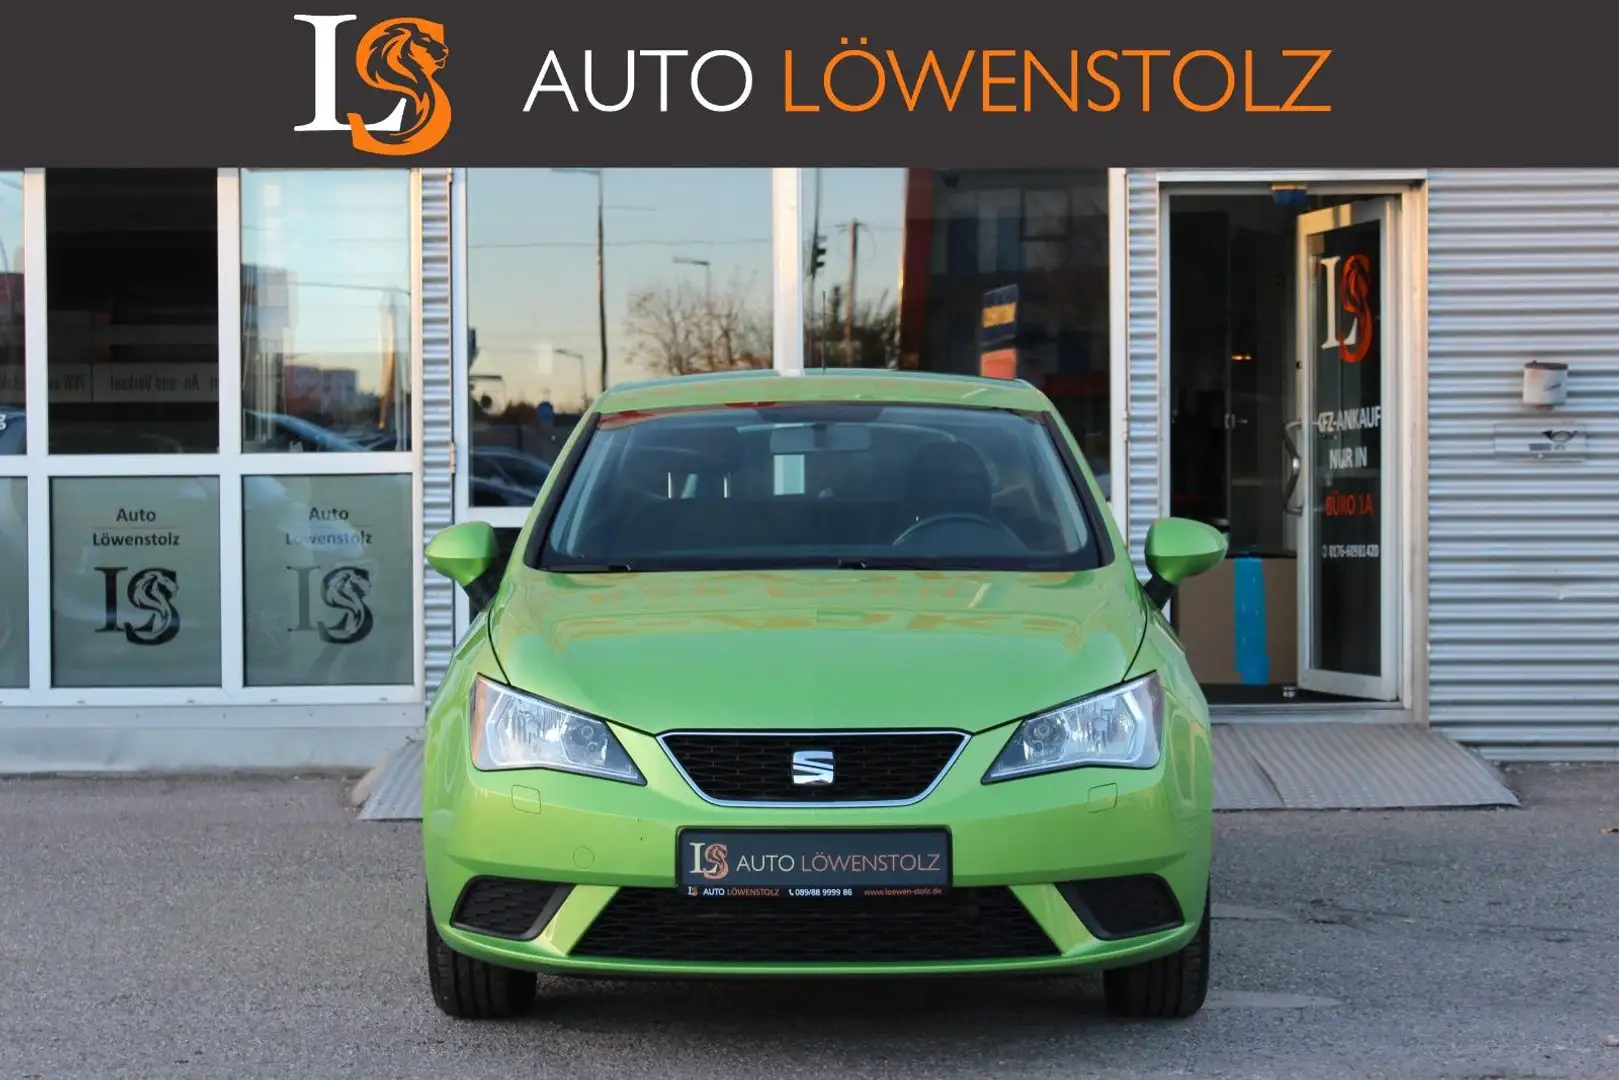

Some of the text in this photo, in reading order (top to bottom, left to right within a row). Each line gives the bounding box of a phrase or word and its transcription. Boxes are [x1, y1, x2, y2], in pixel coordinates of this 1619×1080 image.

[1329, 447, 1367, 469] NUR IN
[116, 507, 157, 522] Auto
[308, 506, 350, 521] Auto
[92, 532, 180, 547] Löwenstolz
[736, 851, 941, 872] AUTO LÖWENSTOLZ
[703, 888, 725, 896] AUTO
[727, 886, 780, 896] LÖWENSTOLZ
[795, 888, 853, 897] 089/88 9999 86
[864, 887, 943, 897] www.loewen-stolz.de
